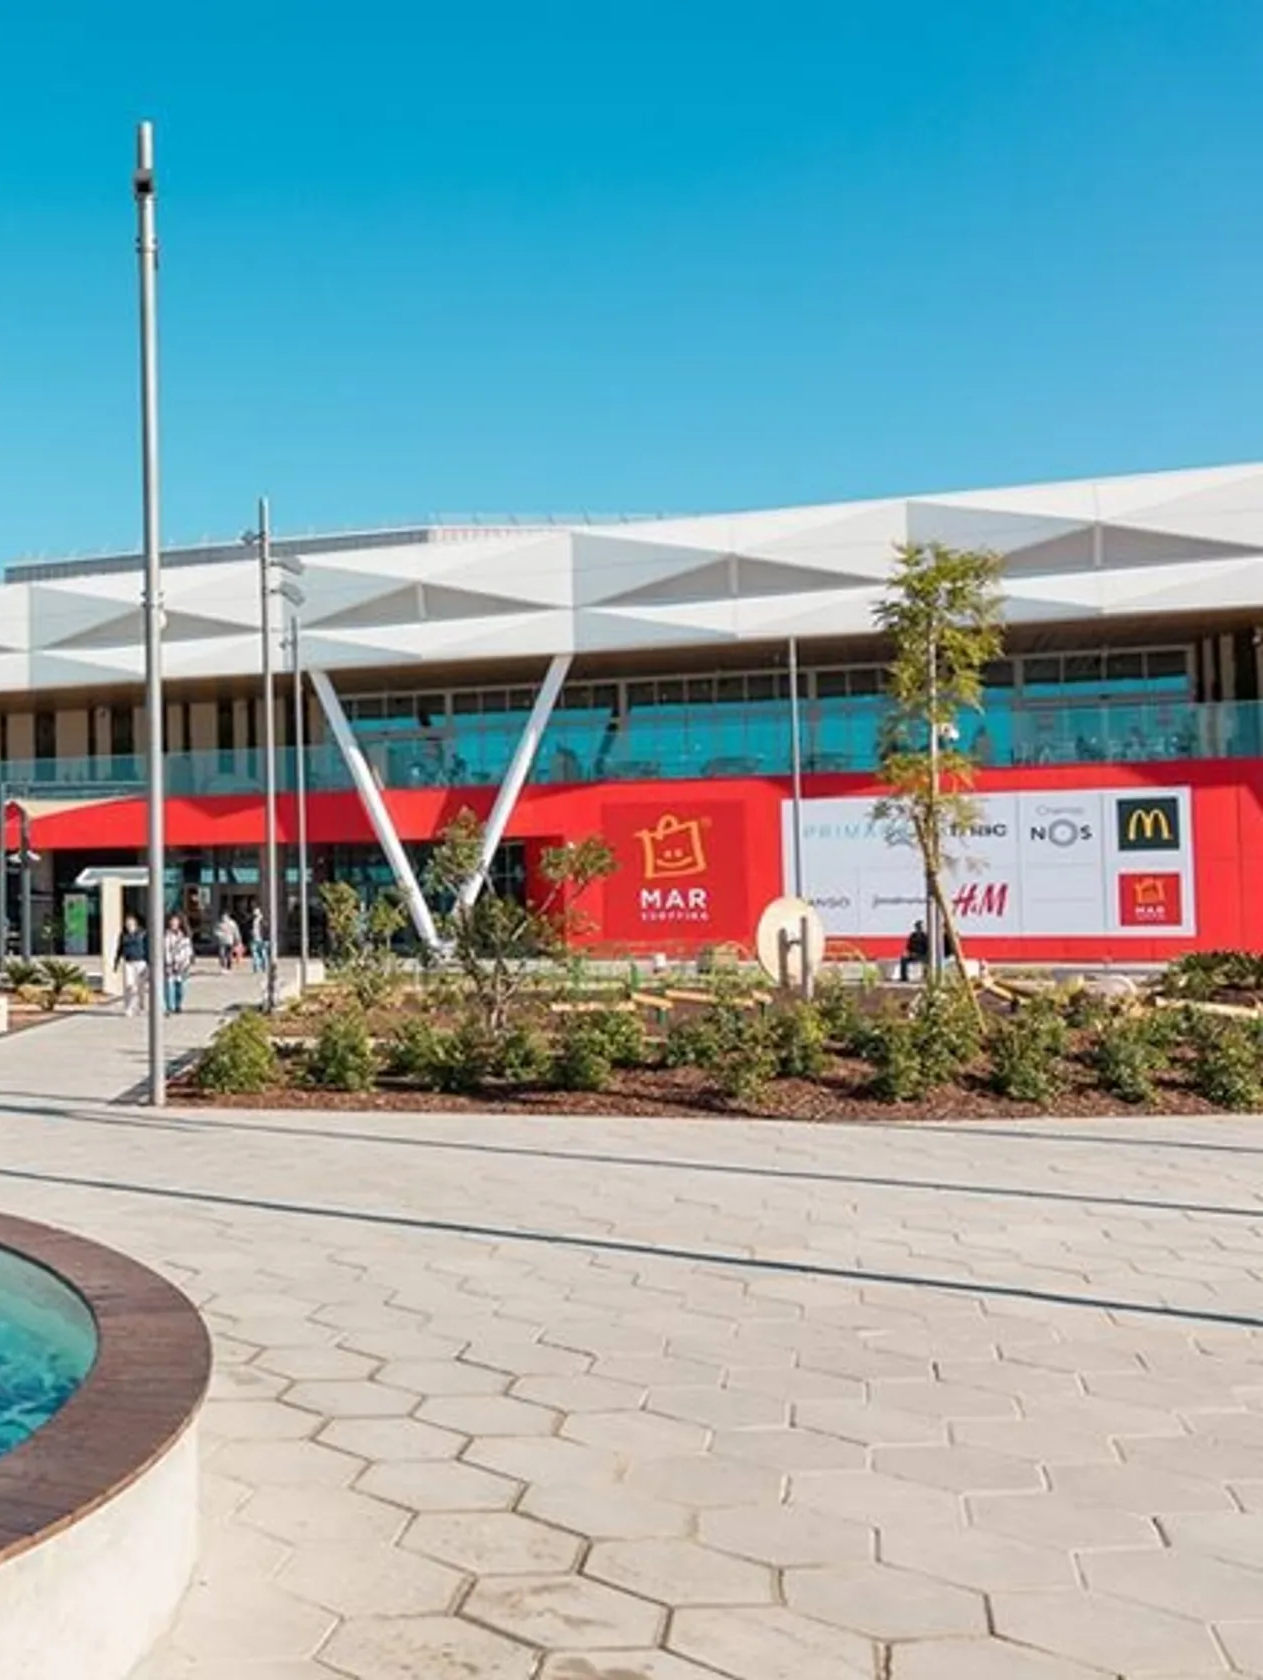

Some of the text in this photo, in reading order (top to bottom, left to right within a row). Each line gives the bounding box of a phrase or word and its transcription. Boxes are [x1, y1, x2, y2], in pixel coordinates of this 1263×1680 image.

[802, 822, 909, 840] PRIMA
[1030, 818, 1093, 848] NOS
[640, 887, 707, 909] MAR
[951, 882, 1009, 918] H&M
